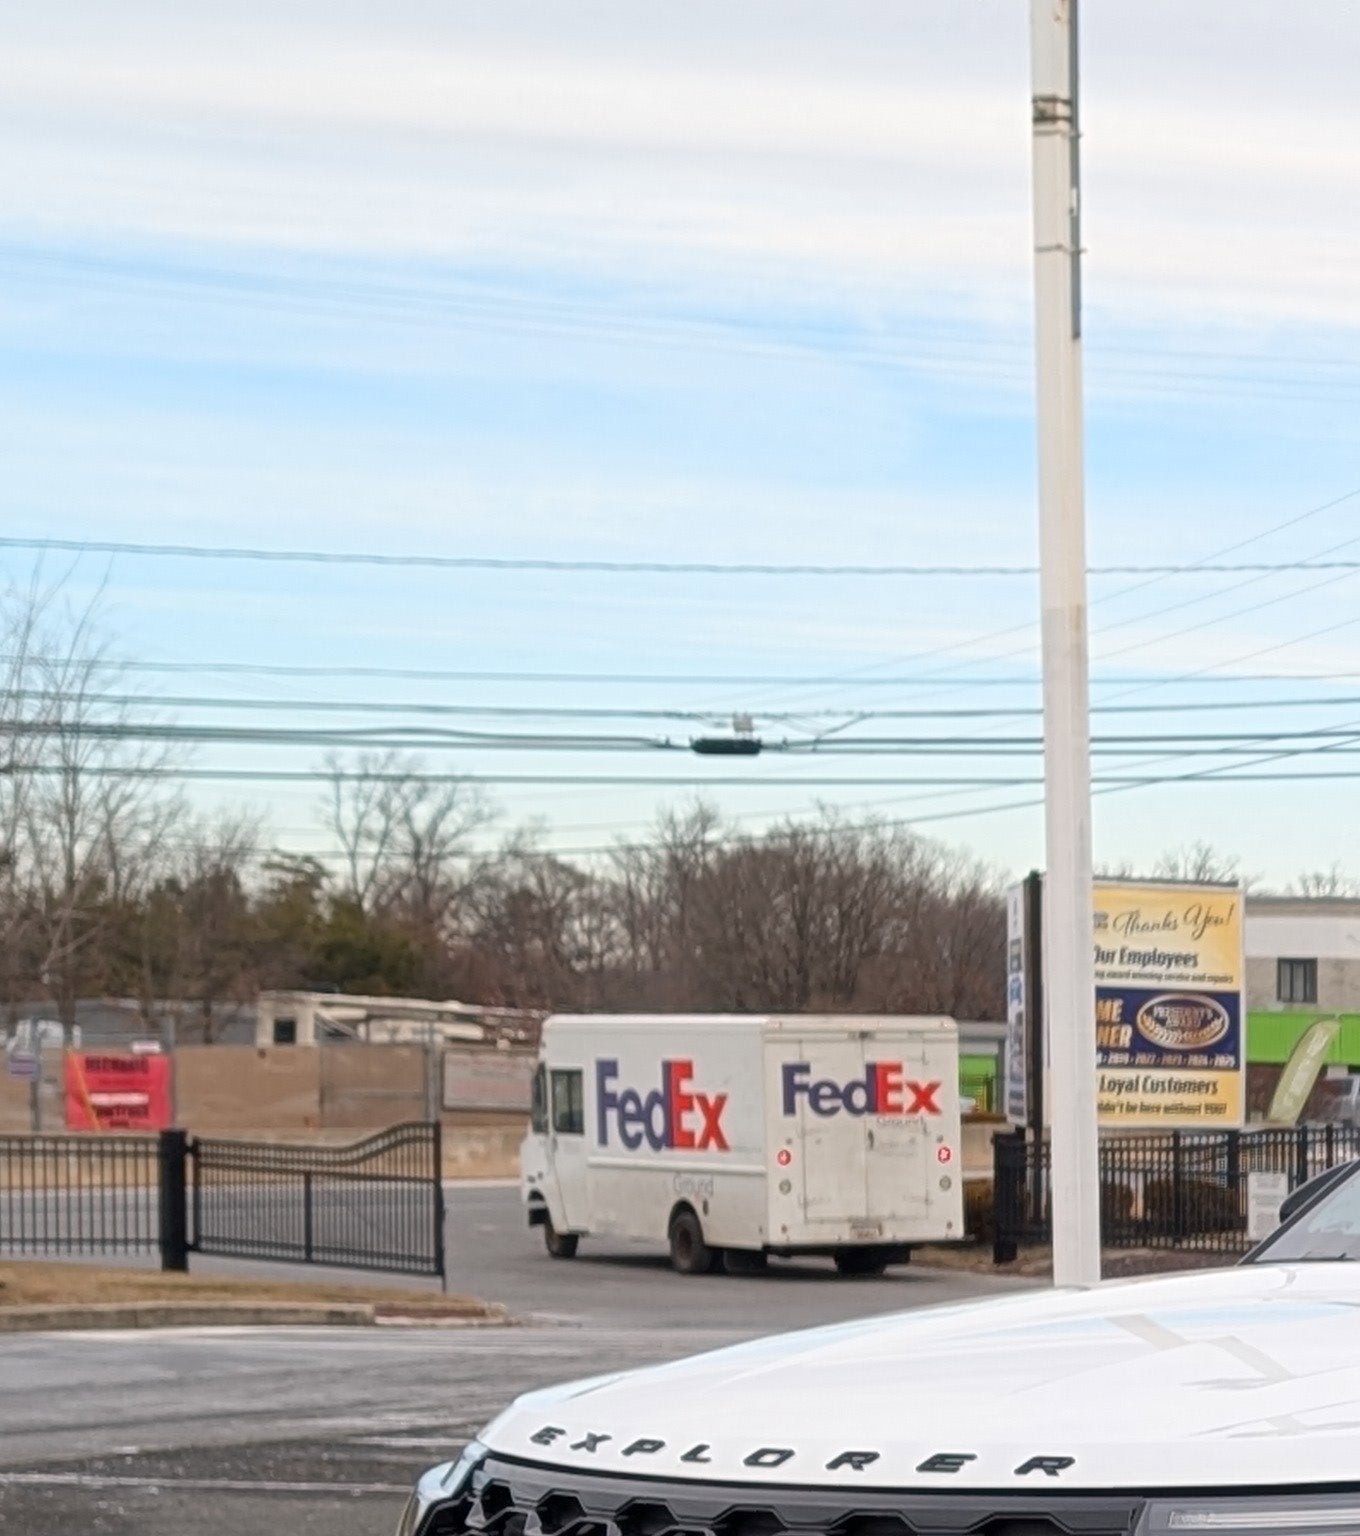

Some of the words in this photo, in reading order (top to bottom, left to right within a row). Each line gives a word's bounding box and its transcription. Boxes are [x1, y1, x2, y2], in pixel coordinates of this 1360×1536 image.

[1113, 909, 1178, 937] Thanks
[1183, 902, 1236, 940] You!
[1118, 946, 1199, 969] Employees
[596, 1059, 729, 1151] FedEx
[781, 1061, 942, 1116] FedEx
[1099, 1074, 1139, 1096] Loyal
[1142, 1075, 1218, 1095] Customers
[529, 1425, 1078, 1478] EXPLORER
